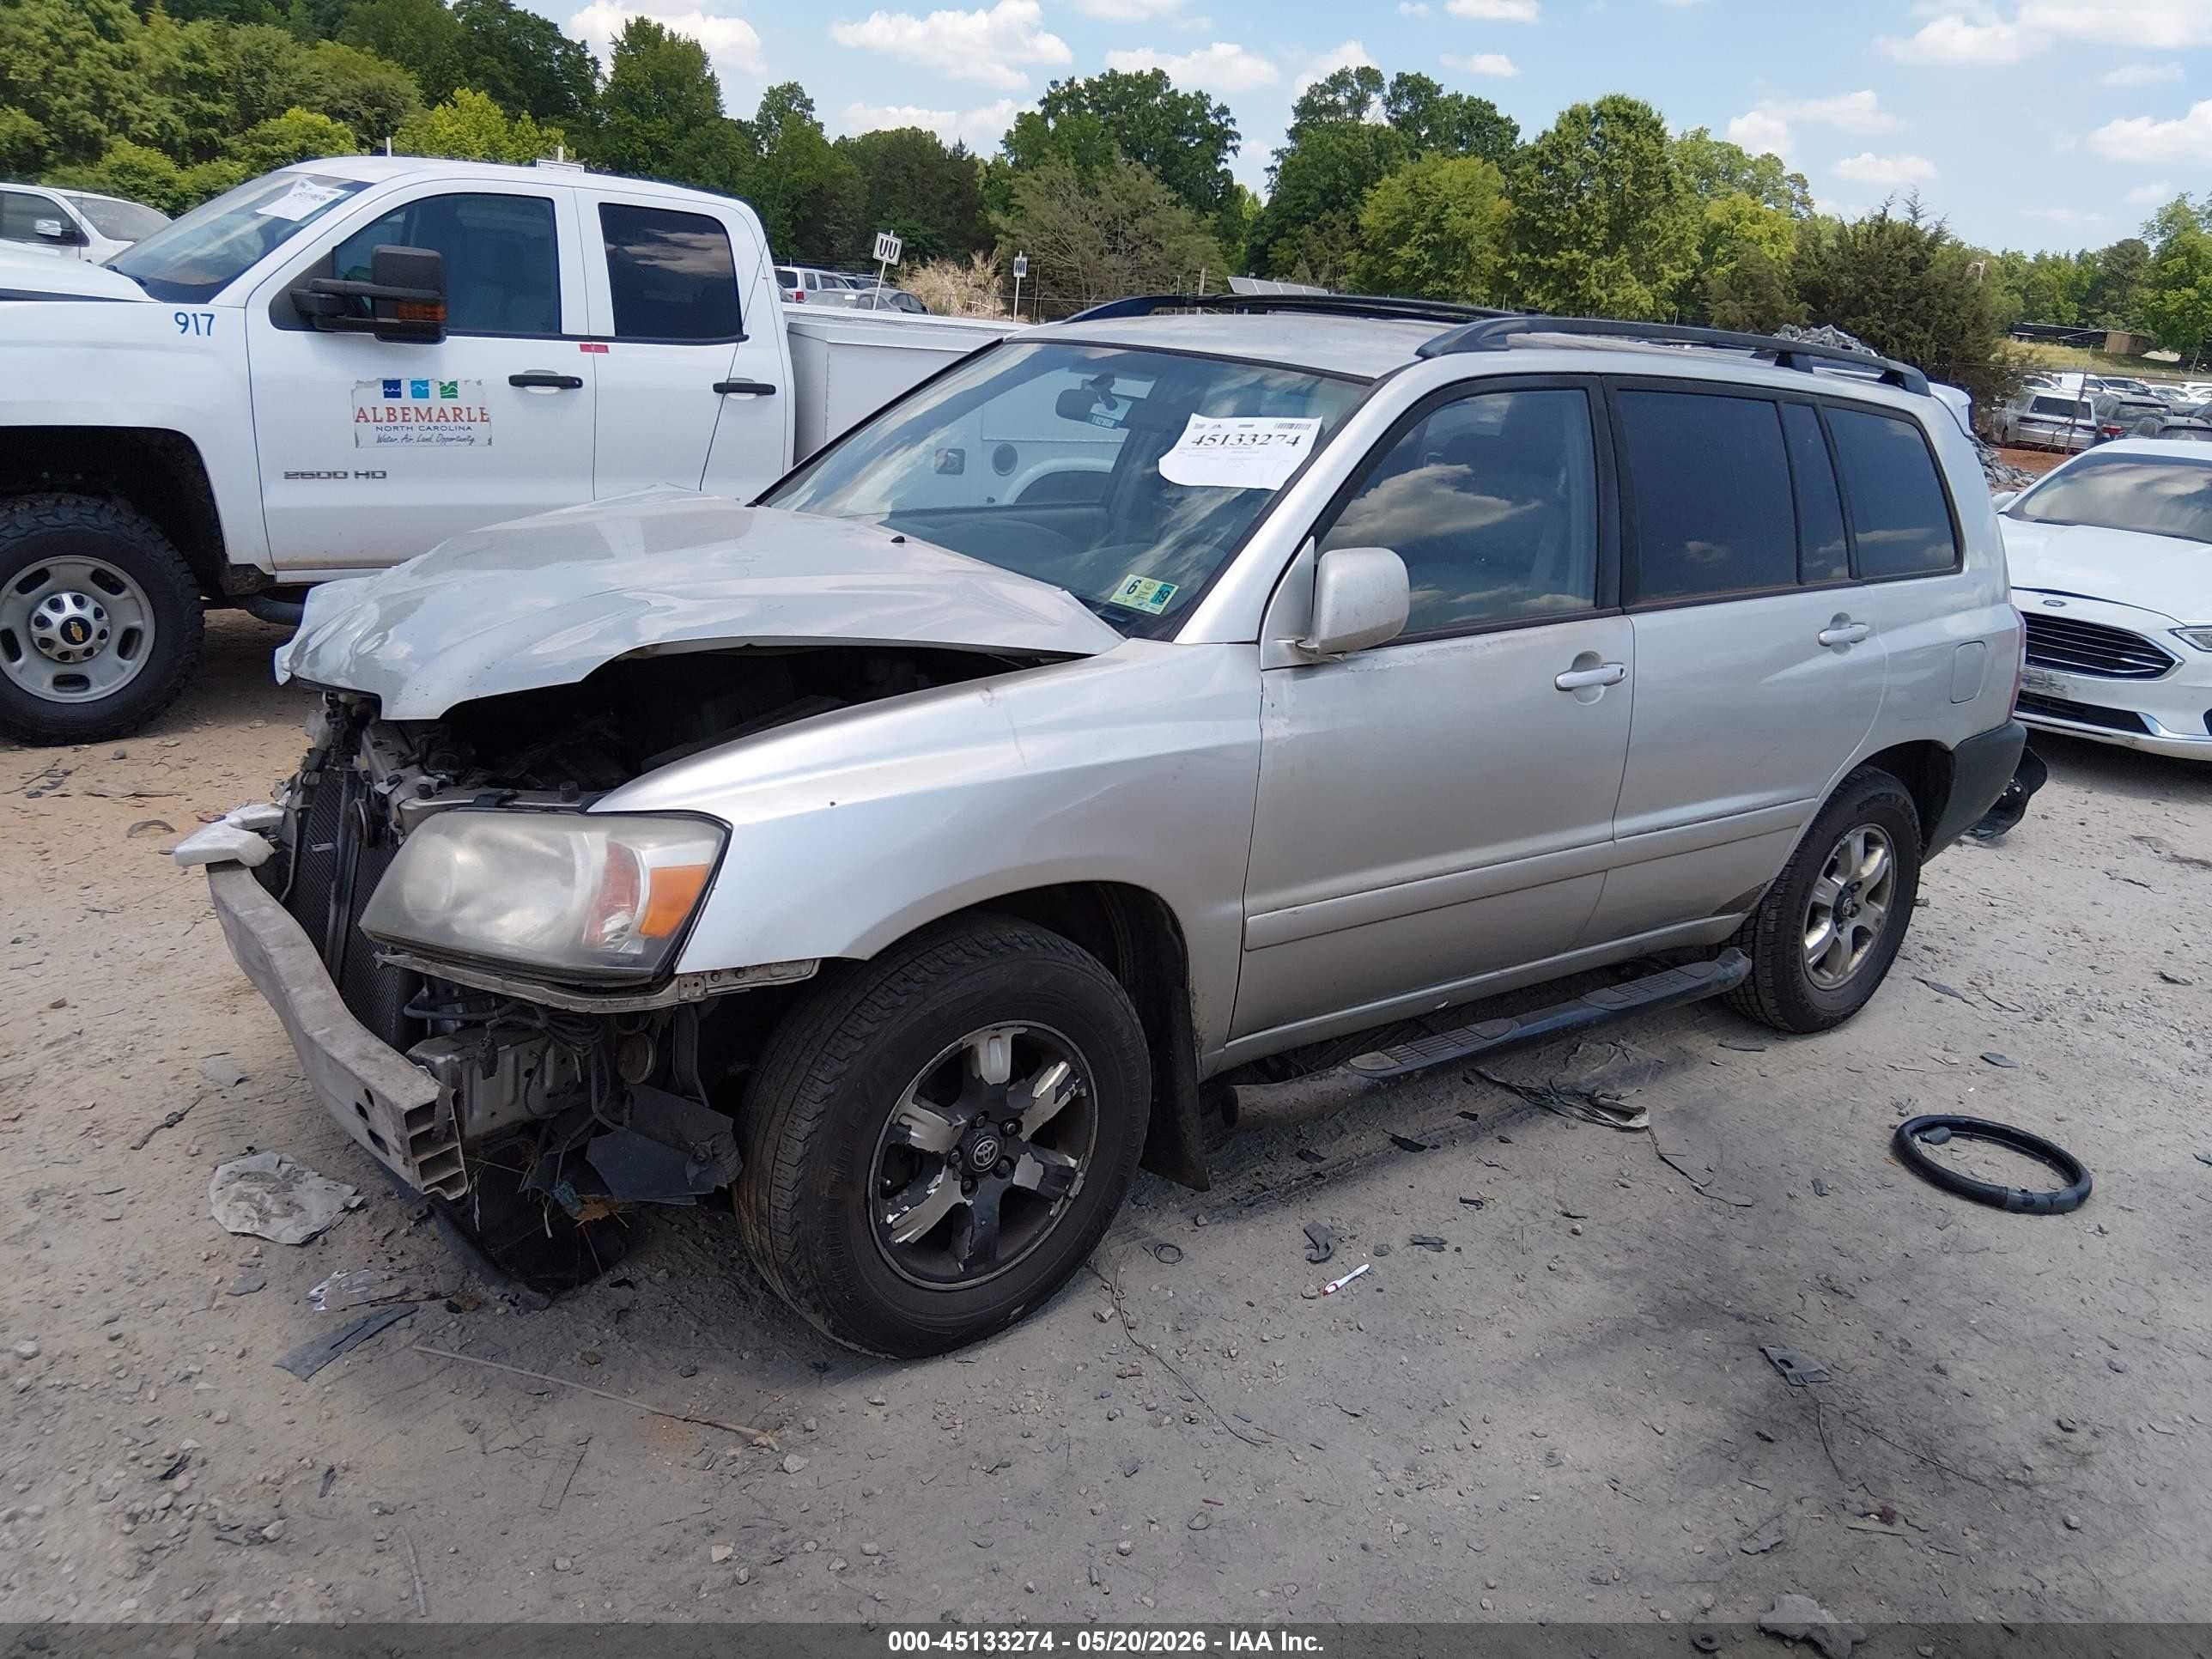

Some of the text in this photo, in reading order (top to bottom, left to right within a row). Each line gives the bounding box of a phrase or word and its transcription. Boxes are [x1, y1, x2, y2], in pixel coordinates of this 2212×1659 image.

[174, 312, 215, 336] 917
[355, 407, 489, 422] ALBEMARLE
[1191, 433, 1301, 447] 45133274
[283, 471, 386, 479] 2500 HD
[1127, 579, 1142, 594] 6
